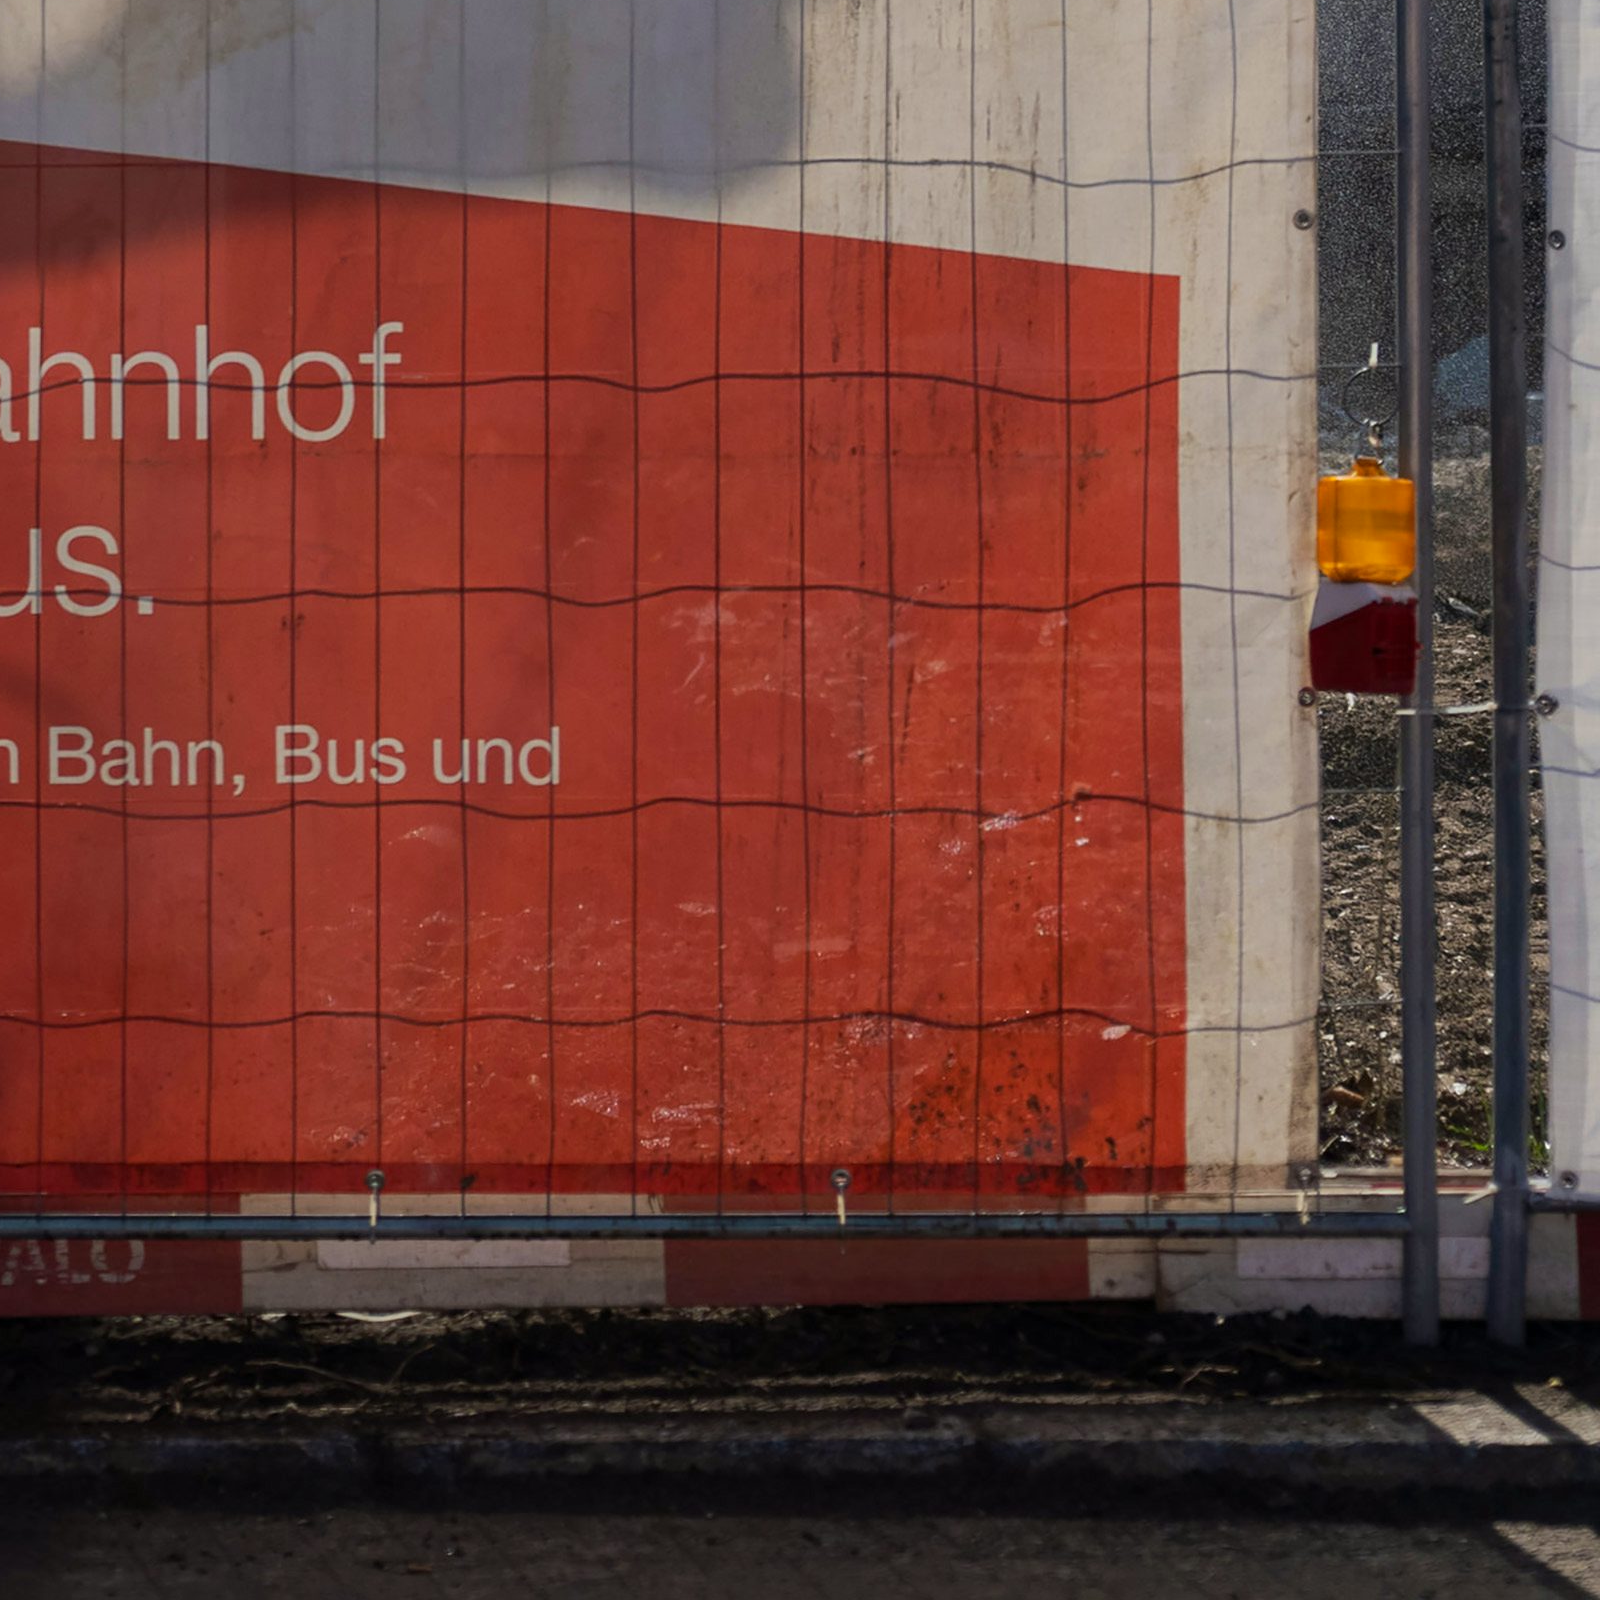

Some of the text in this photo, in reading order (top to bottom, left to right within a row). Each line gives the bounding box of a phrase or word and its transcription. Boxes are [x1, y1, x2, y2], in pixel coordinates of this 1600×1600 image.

[49, 726, 245, 795] Bahn,
[275, 725, 406, 785] Bus
[433, 726, 560, 785] und
